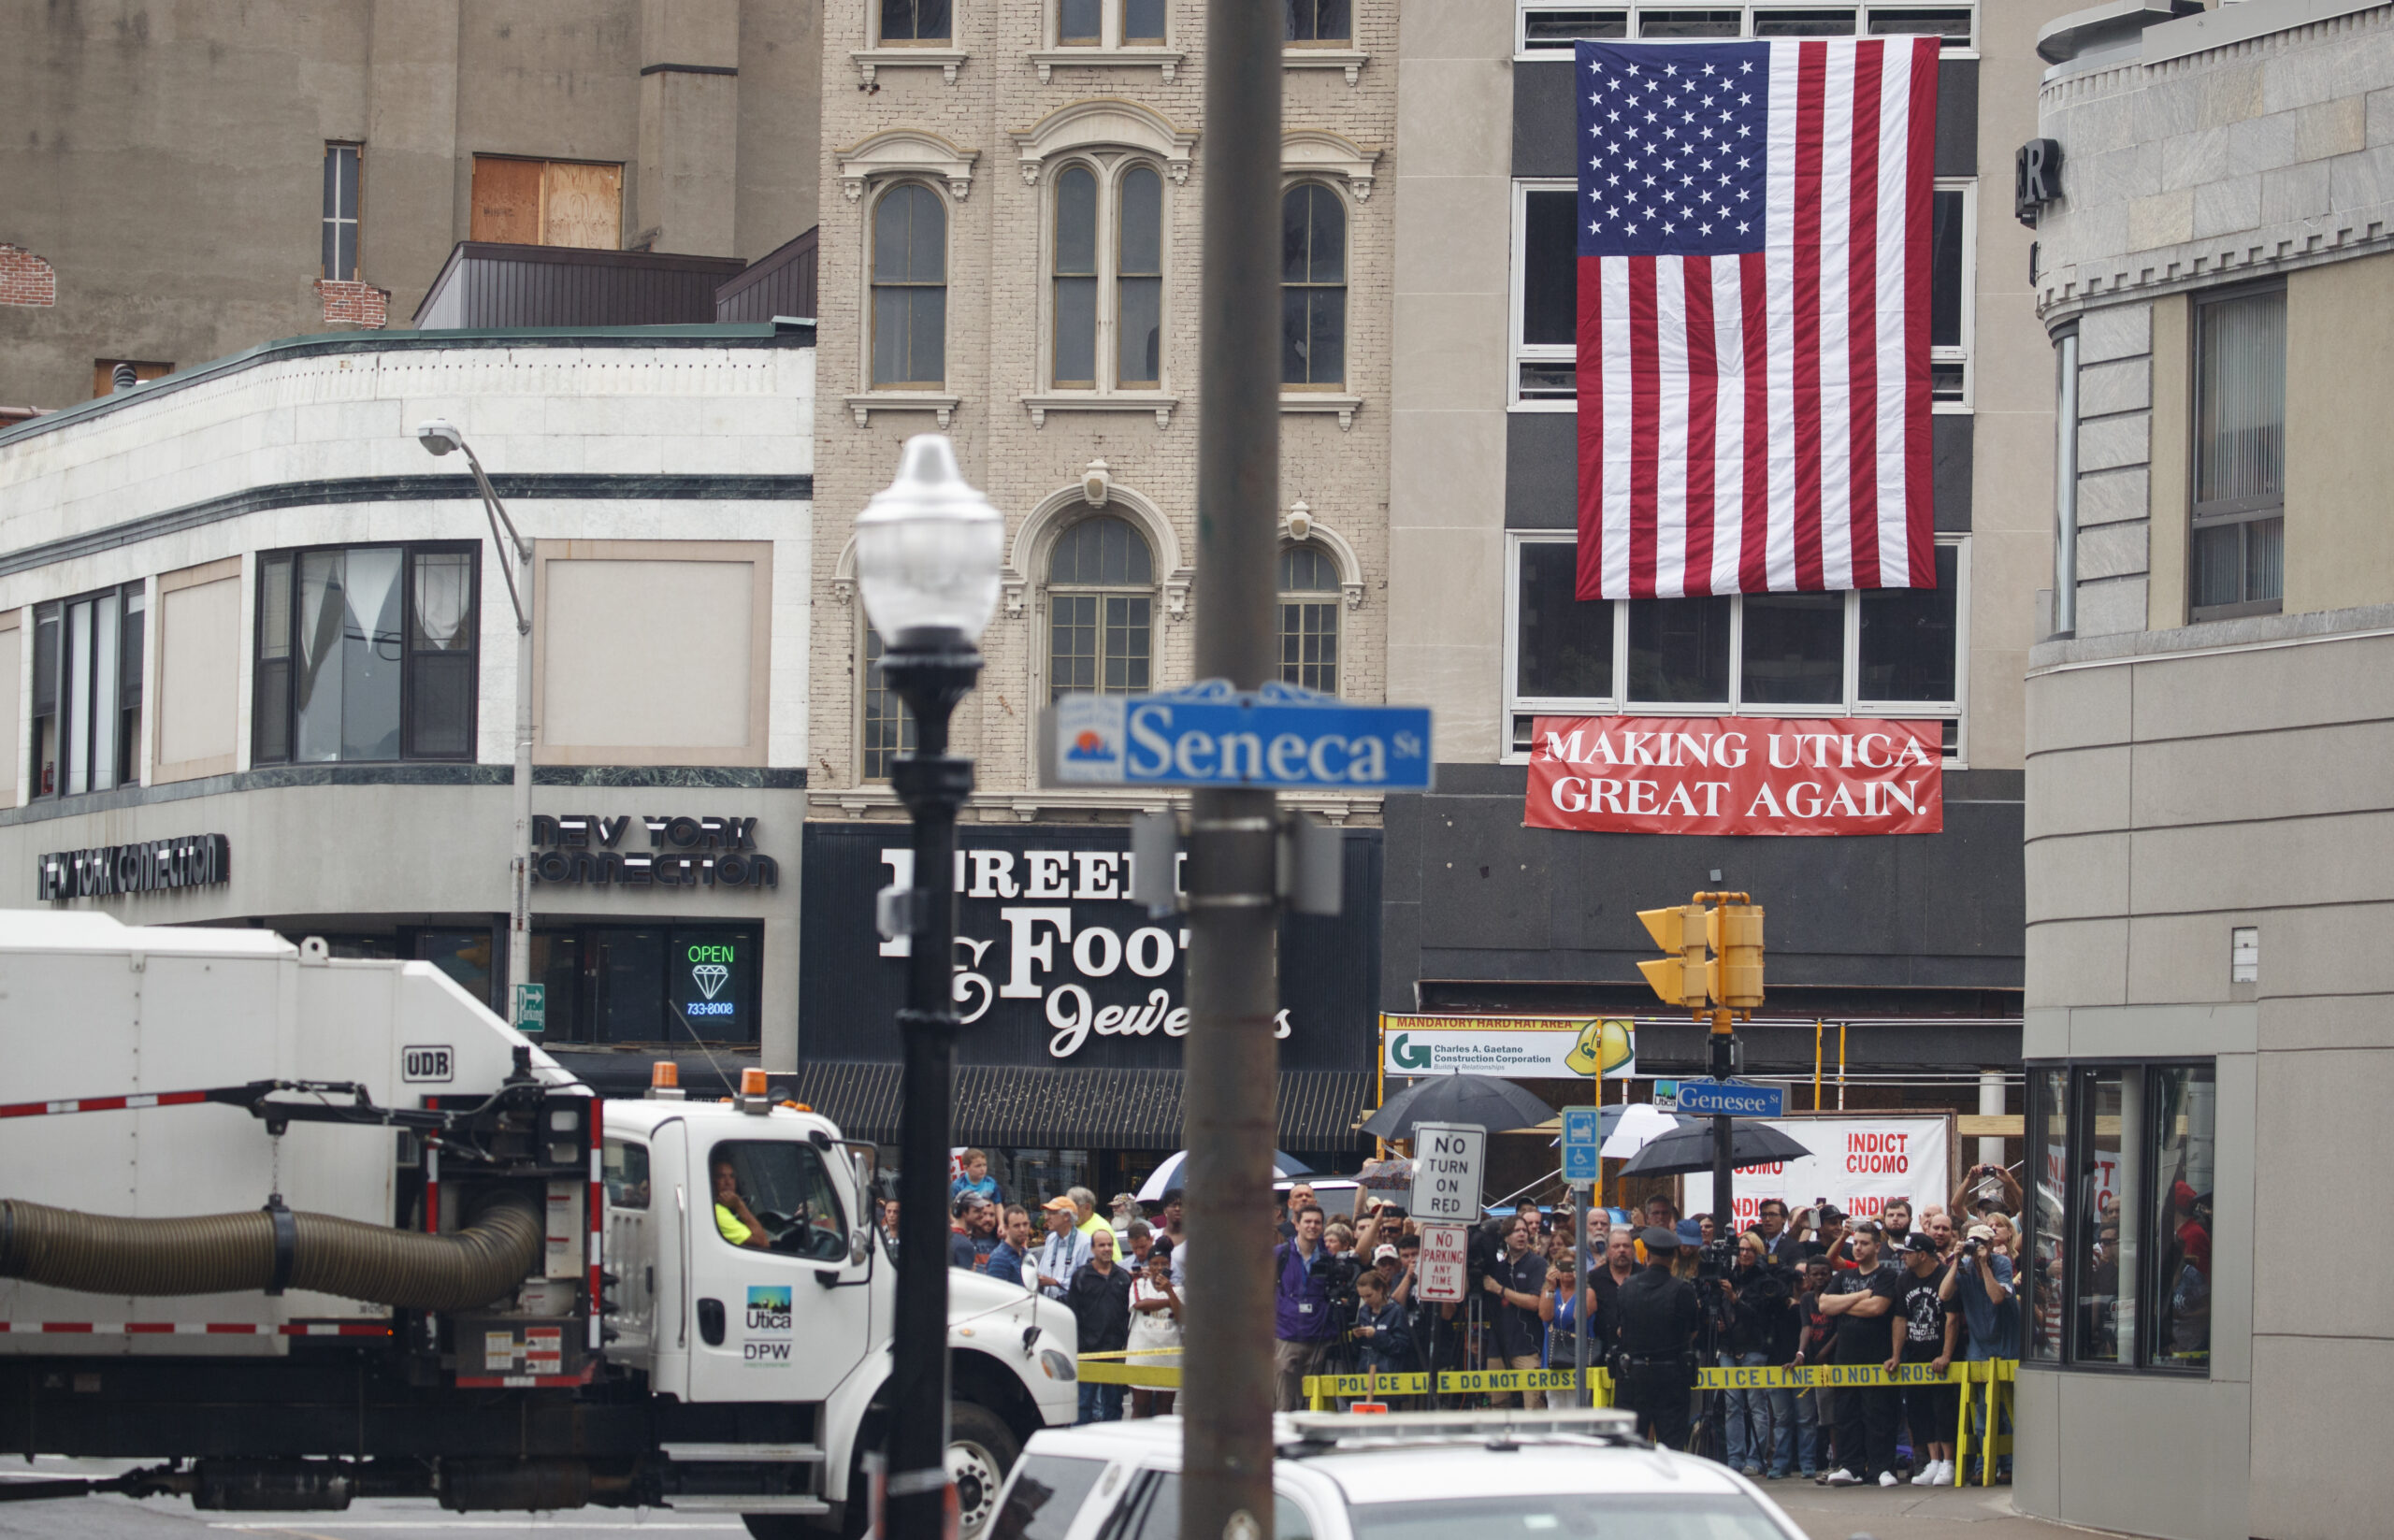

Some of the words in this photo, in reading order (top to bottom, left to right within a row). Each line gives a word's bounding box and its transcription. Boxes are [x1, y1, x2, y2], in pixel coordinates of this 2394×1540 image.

[1128, 705, 1388, 783] Seneca
[1393, 730, 1421, 759] St
[1541, 730, 1749, 768] MAKING
[1767, 733, 1933, 769] UTICA
[1550, 777, 1731, 816] GREAT
[1746, 780, 1926, 818] AGAIN.
[531, 814, 631, 847] NEW
[642, 816, 758, 849] YORK
[37, 852, 73, 900] NEW
[75, 846, 116, 898] YORK
[118, 833, 227, 893] CONNECTION
[688, 945, 733, 962] OPEN
[687, 1002, 733, 1015] 733-8008
[1046, 984, 1292, 1058] Jewes
[1397, 1017, 1473, 1028] MANDATORY
[1477, 1019, 1510, 1028] HARD
[1540, 1020, 1573, 1029] AREA
[1435, 1044, 1470, 1053] Charles
[1484, 1045, 1522, 1054] Gaetano
[1462, 1063, 1505, 1072] Relationships
[1496, 1056, 1550, 1064] Corporation
[1679, 1087, 1766, 1112] Genesee
[1769, 1094, 1779, 1103] St
[1435, 1137, 1465, 1154] NO
[1848, 1133, 1908, 1153] INDICT
[1429, 1159, 1468, 1174] TURN
[1733, 1161, 1783, 1174] OMO
[1846, 1155, 1908, 1173] CUOMO
[1436, 1179, 1459, 1192] ON
[1432, 1198, 1461, 1212] RED
[1731, 1198, 1783, 1216] NDI
[1849, 1197, 1909, 1216] INDI
[1436, 1233, 1453, 1246] NO
[1424, 1249, 1464, 1264] PARKING
[1434, 1265, 1451, 1274] ANY
[1432, 1275, 1451, 1286] TIME
[746, 1310, 791, 1329] Utica
[744, 1344, 791, 1360] DPW
[1338, 1376, 1399, 1392] POLCE
[1412, 1375, 1450, 1390] LIE
[1461, 1374, 1481, 1389] DO
[1489, 1374, 1519, 1388] NOT
[1698, 1369, 1760, 1386] OLICE
[1848, 1367, 1881, 1383] NOT
